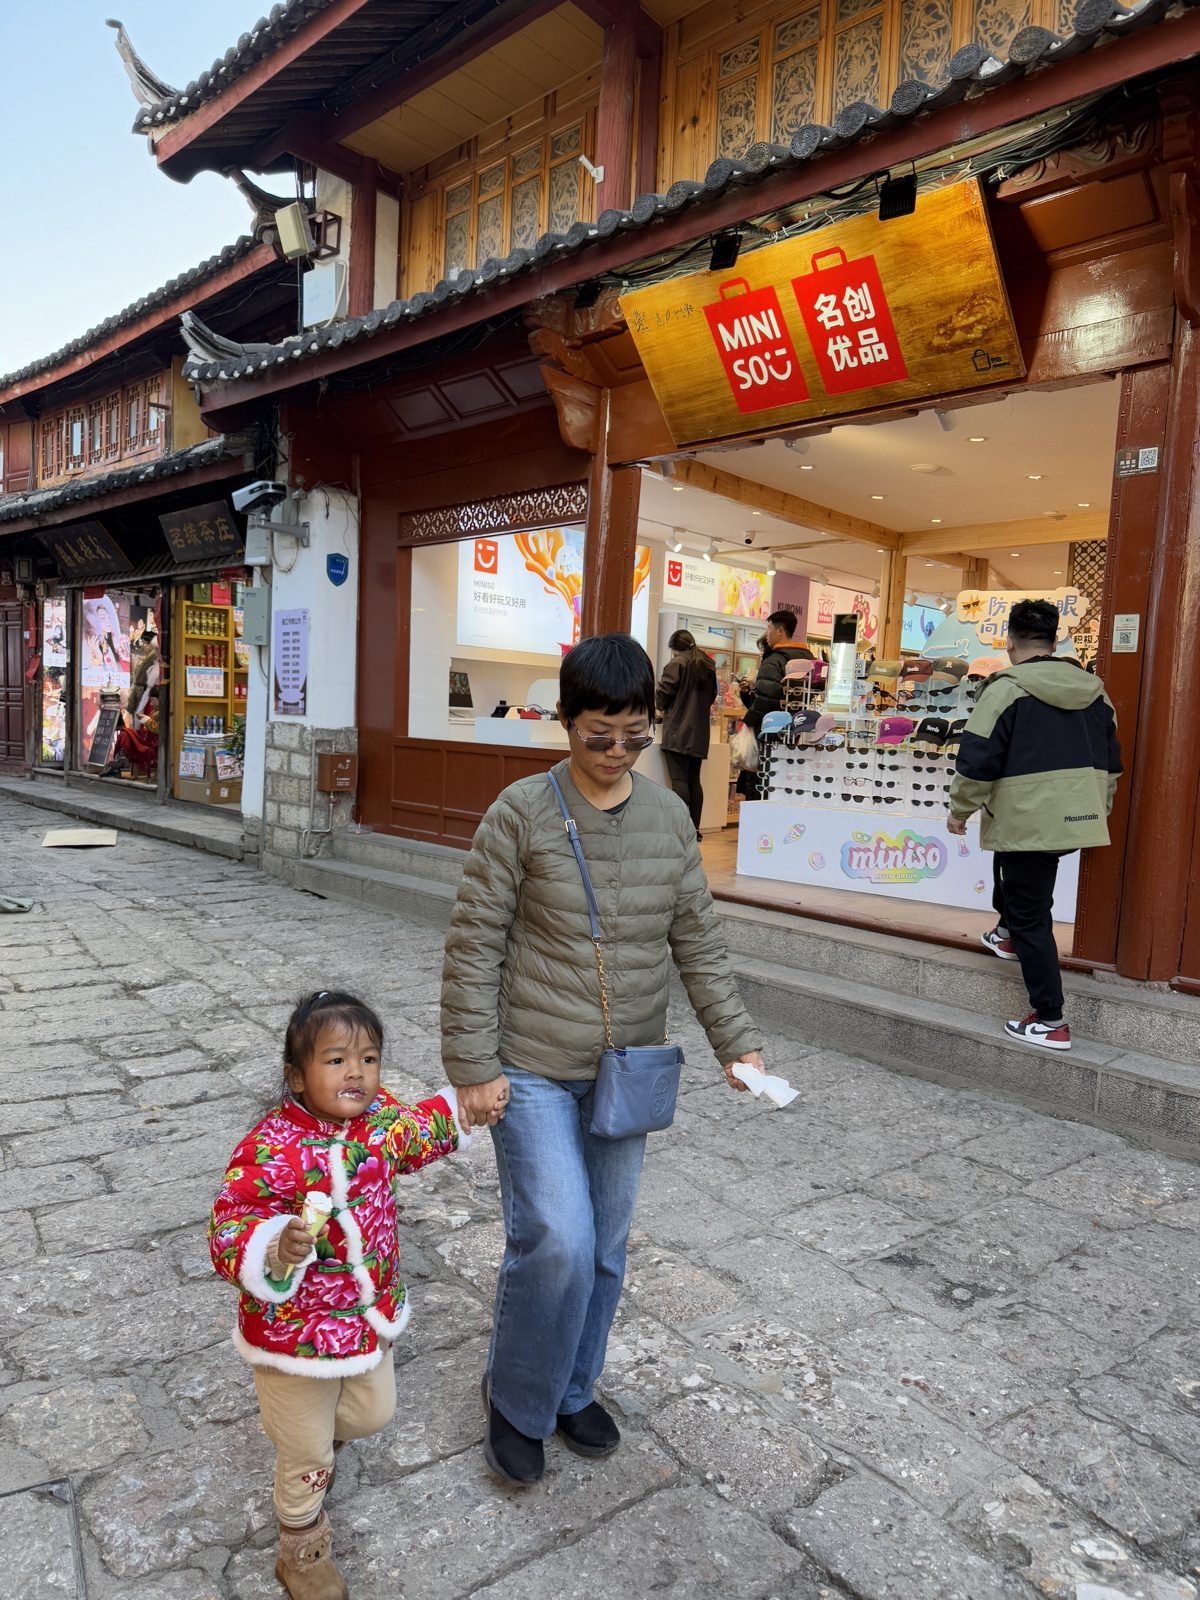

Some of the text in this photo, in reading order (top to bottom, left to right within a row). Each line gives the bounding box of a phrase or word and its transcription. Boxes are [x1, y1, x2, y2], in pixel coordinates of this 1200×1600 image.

[814, 282, 876, 331] 名创
[717, 308, 782, 352] MINI
[826, 326, 889, 373] 优品
[169, 516, 235, 549] 茗缘茶庄
[473, 578, 496, 590] MINISO
[473, 591, 527, 609] 好看好玩又好用
[777, 601, 803, 616] KUROMI
[818, 599, 835, 615] TOY
[988, 595, 1079, 616] 防眼
[945, 661, 953, 669] R
[884, 723, 891, 731] R
[926, 725, 940, 733] Needs
[1064, 812, 1099, 823] Mountain
[848, 835, 941, 870] miniso
